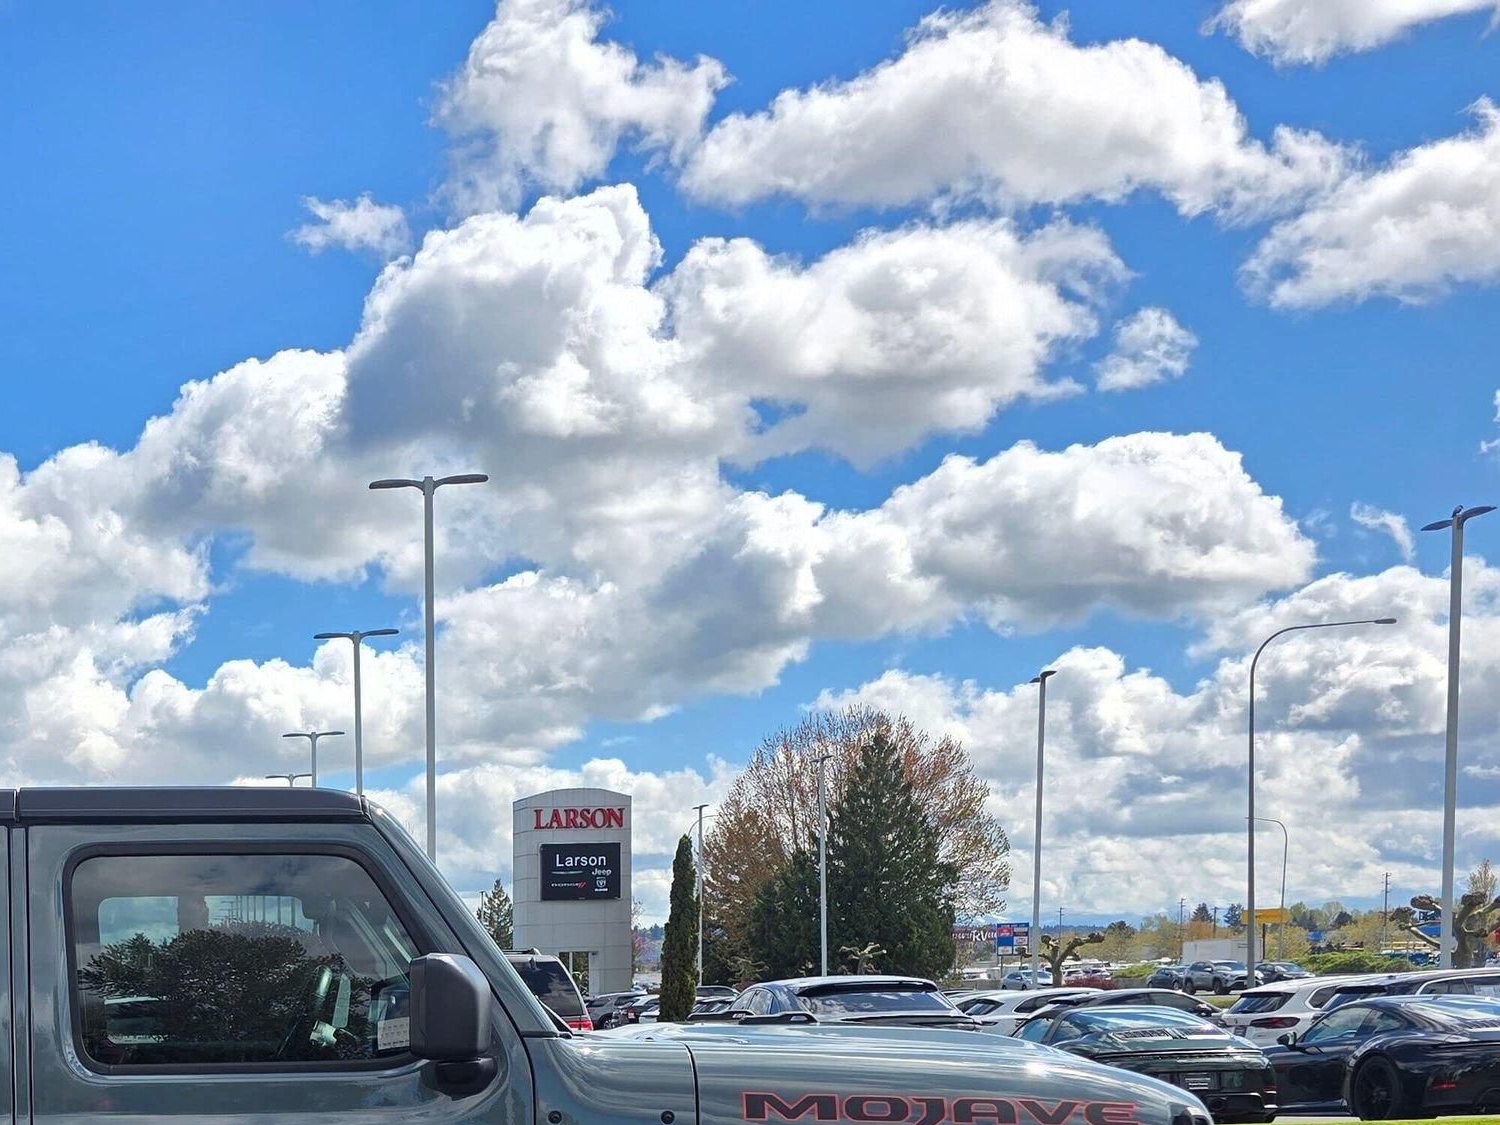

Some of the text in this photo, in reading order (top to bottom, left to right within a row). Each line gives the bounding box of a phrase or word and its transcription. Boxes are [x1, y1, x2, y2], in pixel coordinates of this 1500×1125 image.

[534, 807, 625, 830] LARSON
[555, 853, 607, 867] Larson
[591, 867, 612, 877] Jeep
[972, 929, 989, 942] RV
